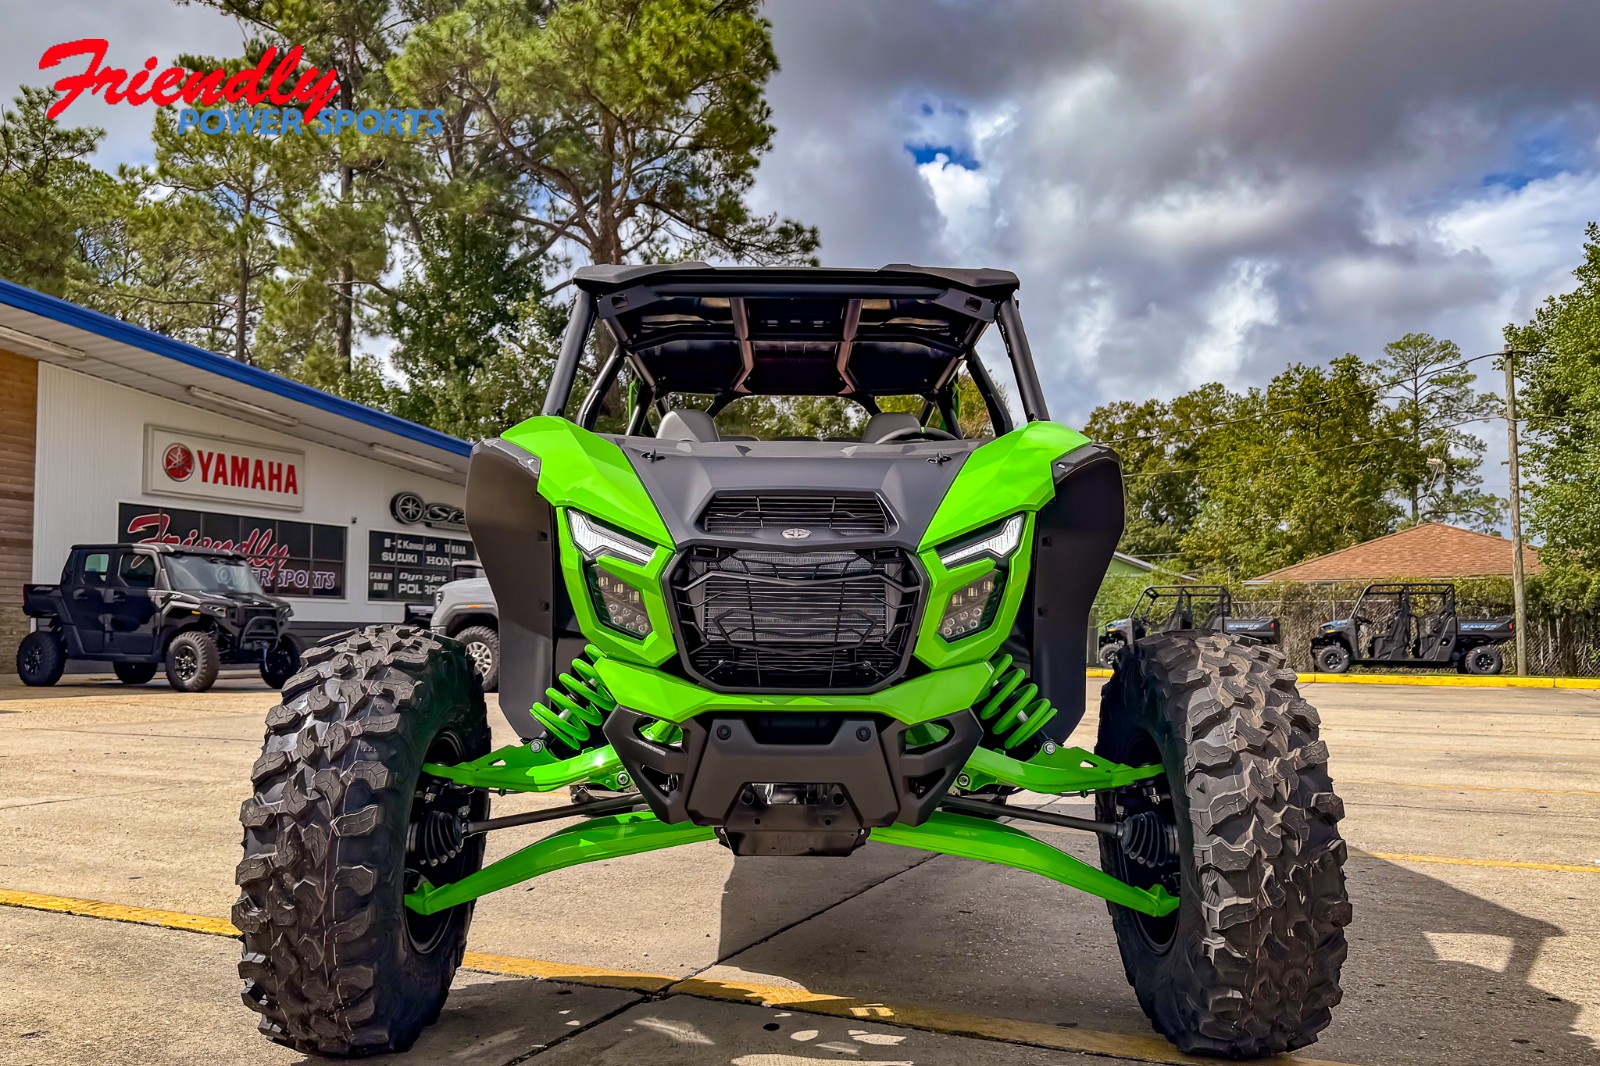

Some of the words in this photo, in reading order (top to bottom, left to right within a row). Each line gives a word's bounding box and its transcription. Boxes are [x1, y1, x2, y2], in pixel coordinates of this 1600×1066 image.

[197, 449, 298, 495] YAMAHA
[403, 540, 437, 552] Kawaaki
[381, 551, 418, 563] SUZUKI
[426, 555, 465, 566] HON
[373, 582, 389, 591] BMW
